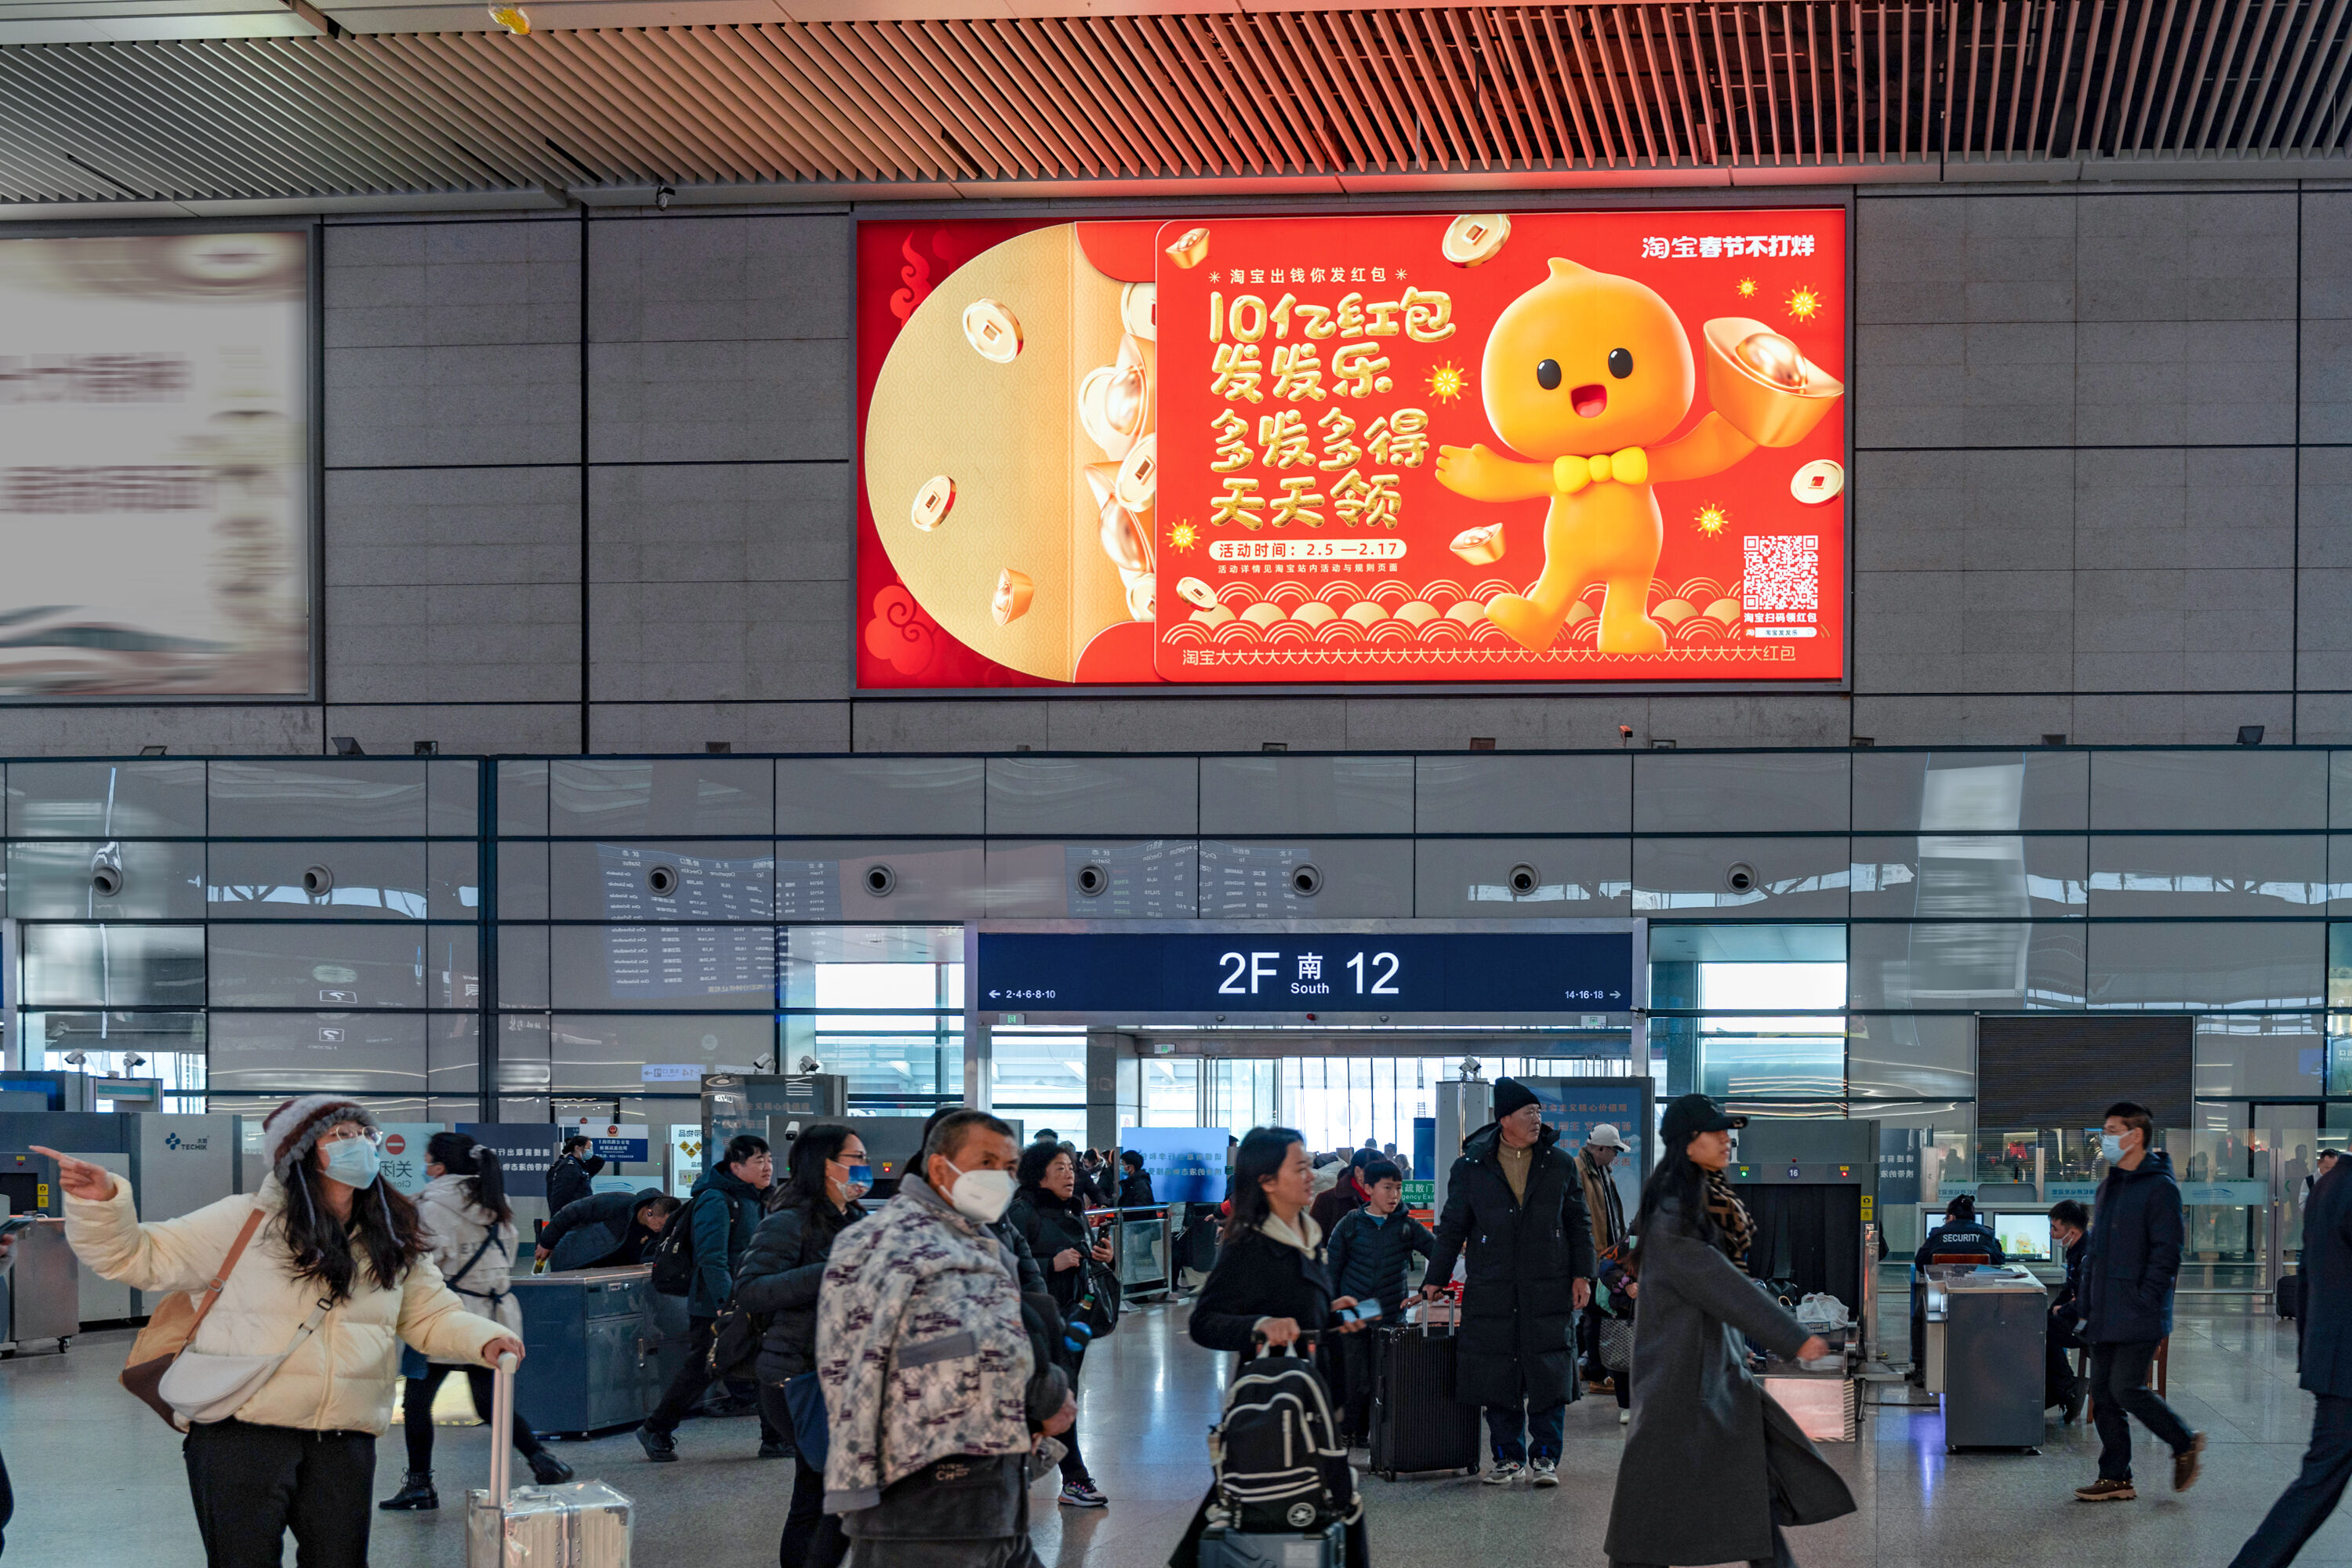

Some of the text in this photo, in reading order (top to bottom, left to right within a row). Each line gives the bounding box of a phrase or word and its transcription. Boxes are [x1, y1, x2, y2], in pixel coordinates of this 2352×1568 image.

[1642, 234, 1815, 259] 淘宝春节不打烊
[1230, 267, 1386, 284] 淘宝出钱你发红包
[1210, 286, 1456, 343] 10亿红包
[1210, 342, 1393, 404] 发发乐
[1210, 407, 1429, 472] 多发多得
[1210, 469, 1402, 531] 天天领
[1218, 563, 1398, 573] 活动详情见淘宝站内活动与规则页面
[1744, 612, 1817, 622] 淘宝扫码领红包
[1218, 952, 1279, 993] 2F
[1298, 952, 1323, 980] 南
[1347, 952, 1399, 994] 12
[1290, 982, 1330, 994] South
[1402, 1184, 1435, 1192] 疏散门
[1943, 1233, 1980, 1243] SECURITY
